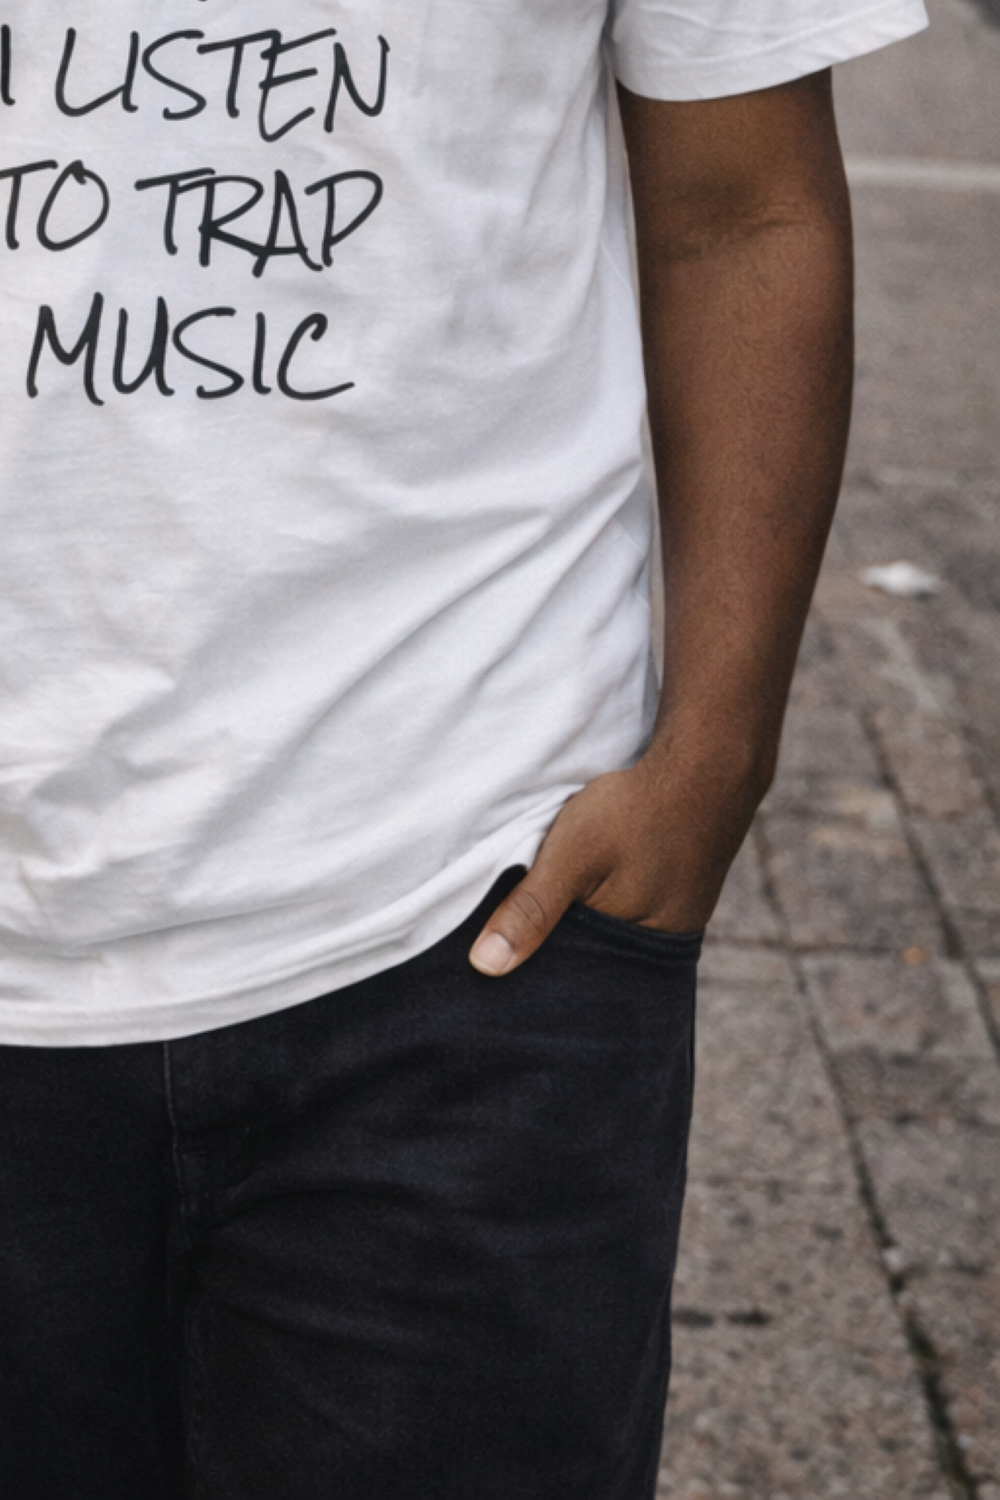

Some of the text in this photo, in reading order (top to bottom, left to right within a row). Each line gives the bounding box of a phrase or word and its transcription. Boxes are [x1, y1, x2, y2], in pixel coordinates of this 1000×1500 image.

[0, 23, 392, 144] I LISTEN
[133, 166, 384, 279] TRAP
[25, 291, 356, 407] MUSIC
